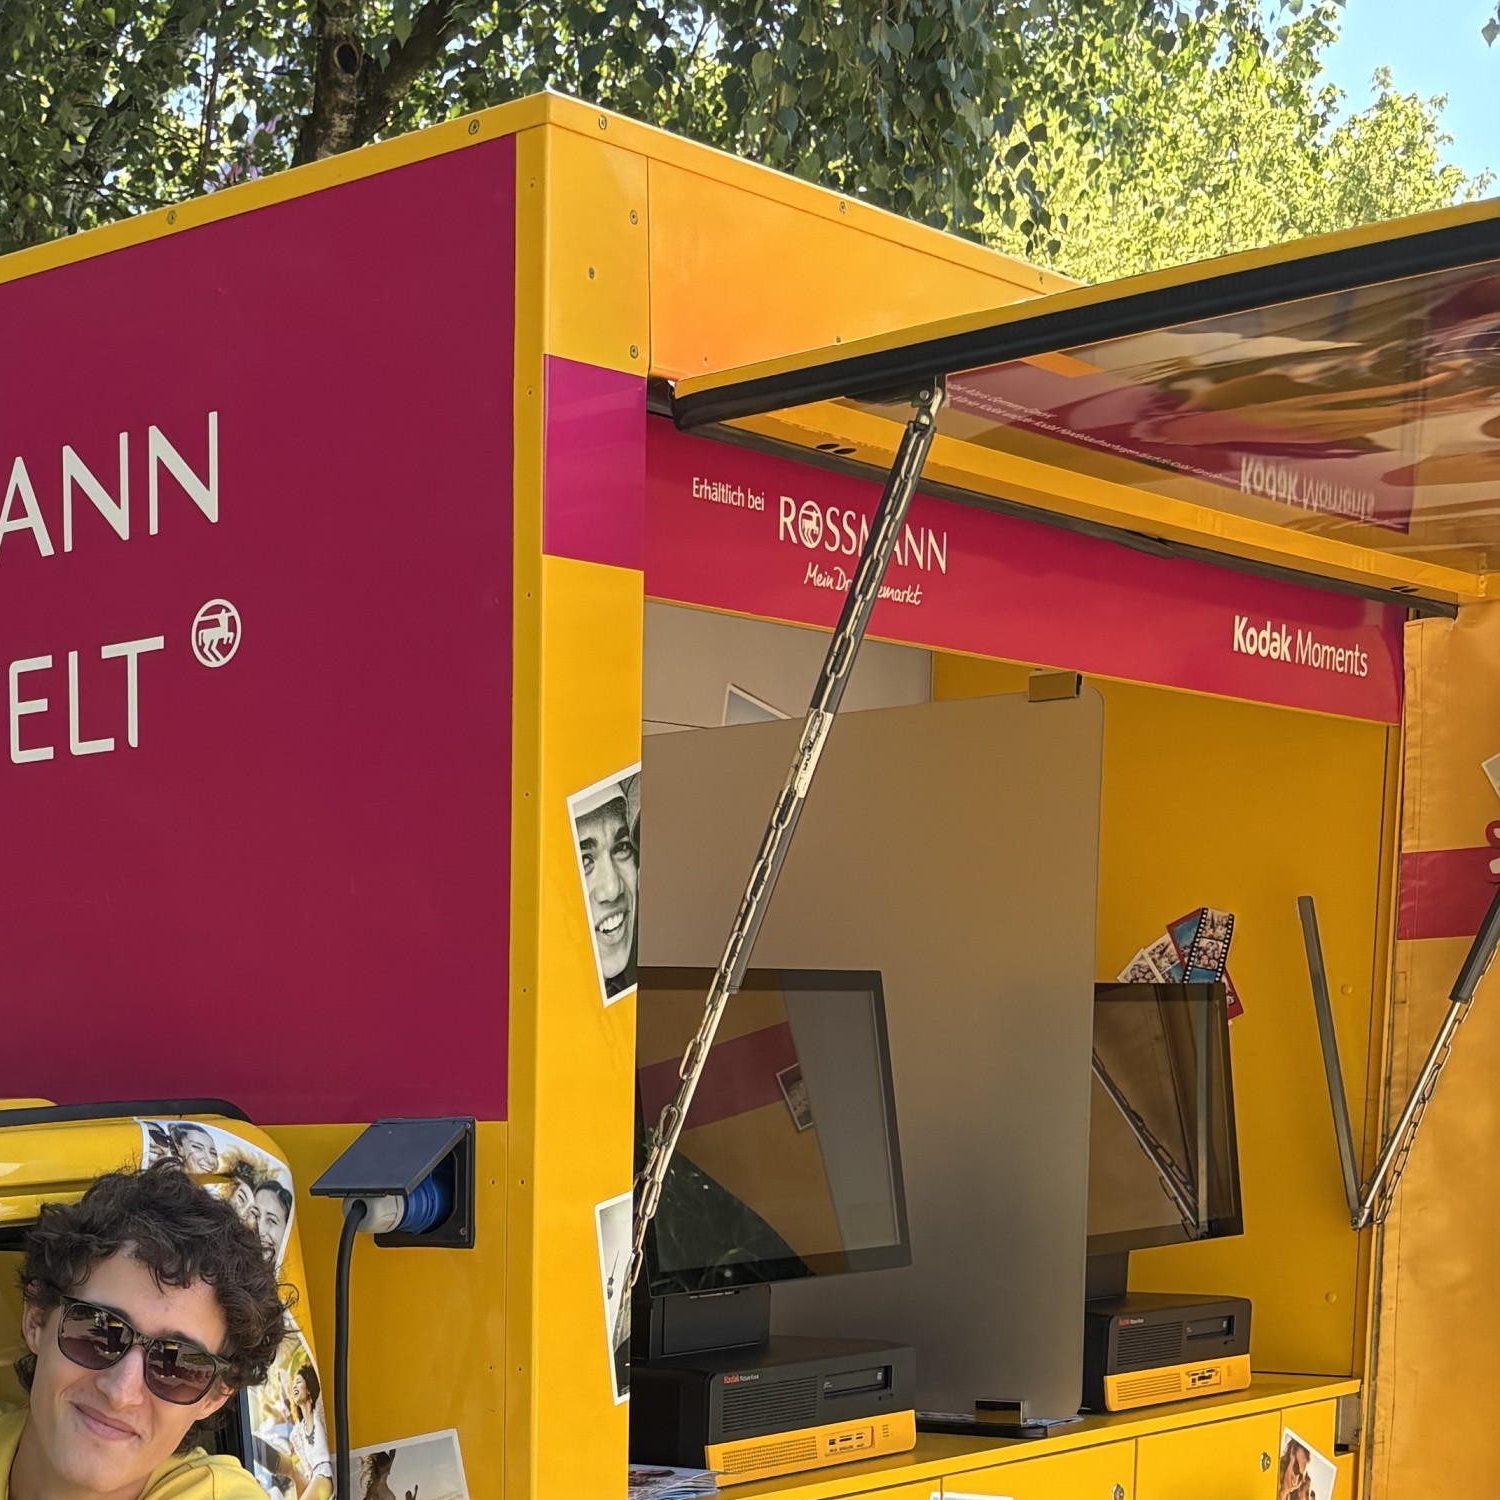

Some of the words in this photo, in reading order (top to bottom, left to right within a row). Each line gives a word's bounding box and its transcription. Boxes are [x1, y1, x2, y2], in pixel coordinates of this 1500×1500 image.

[692, 477, 745, 508] Erhältlich
[747, 488, 765, 512] bei
[778, 495, 948, 575] ROSSNN
[803, 561, 834, 590] Mein
[1232, 614, 1293, 662] Kodak
[1295, 628, 1368, 678] Moments
